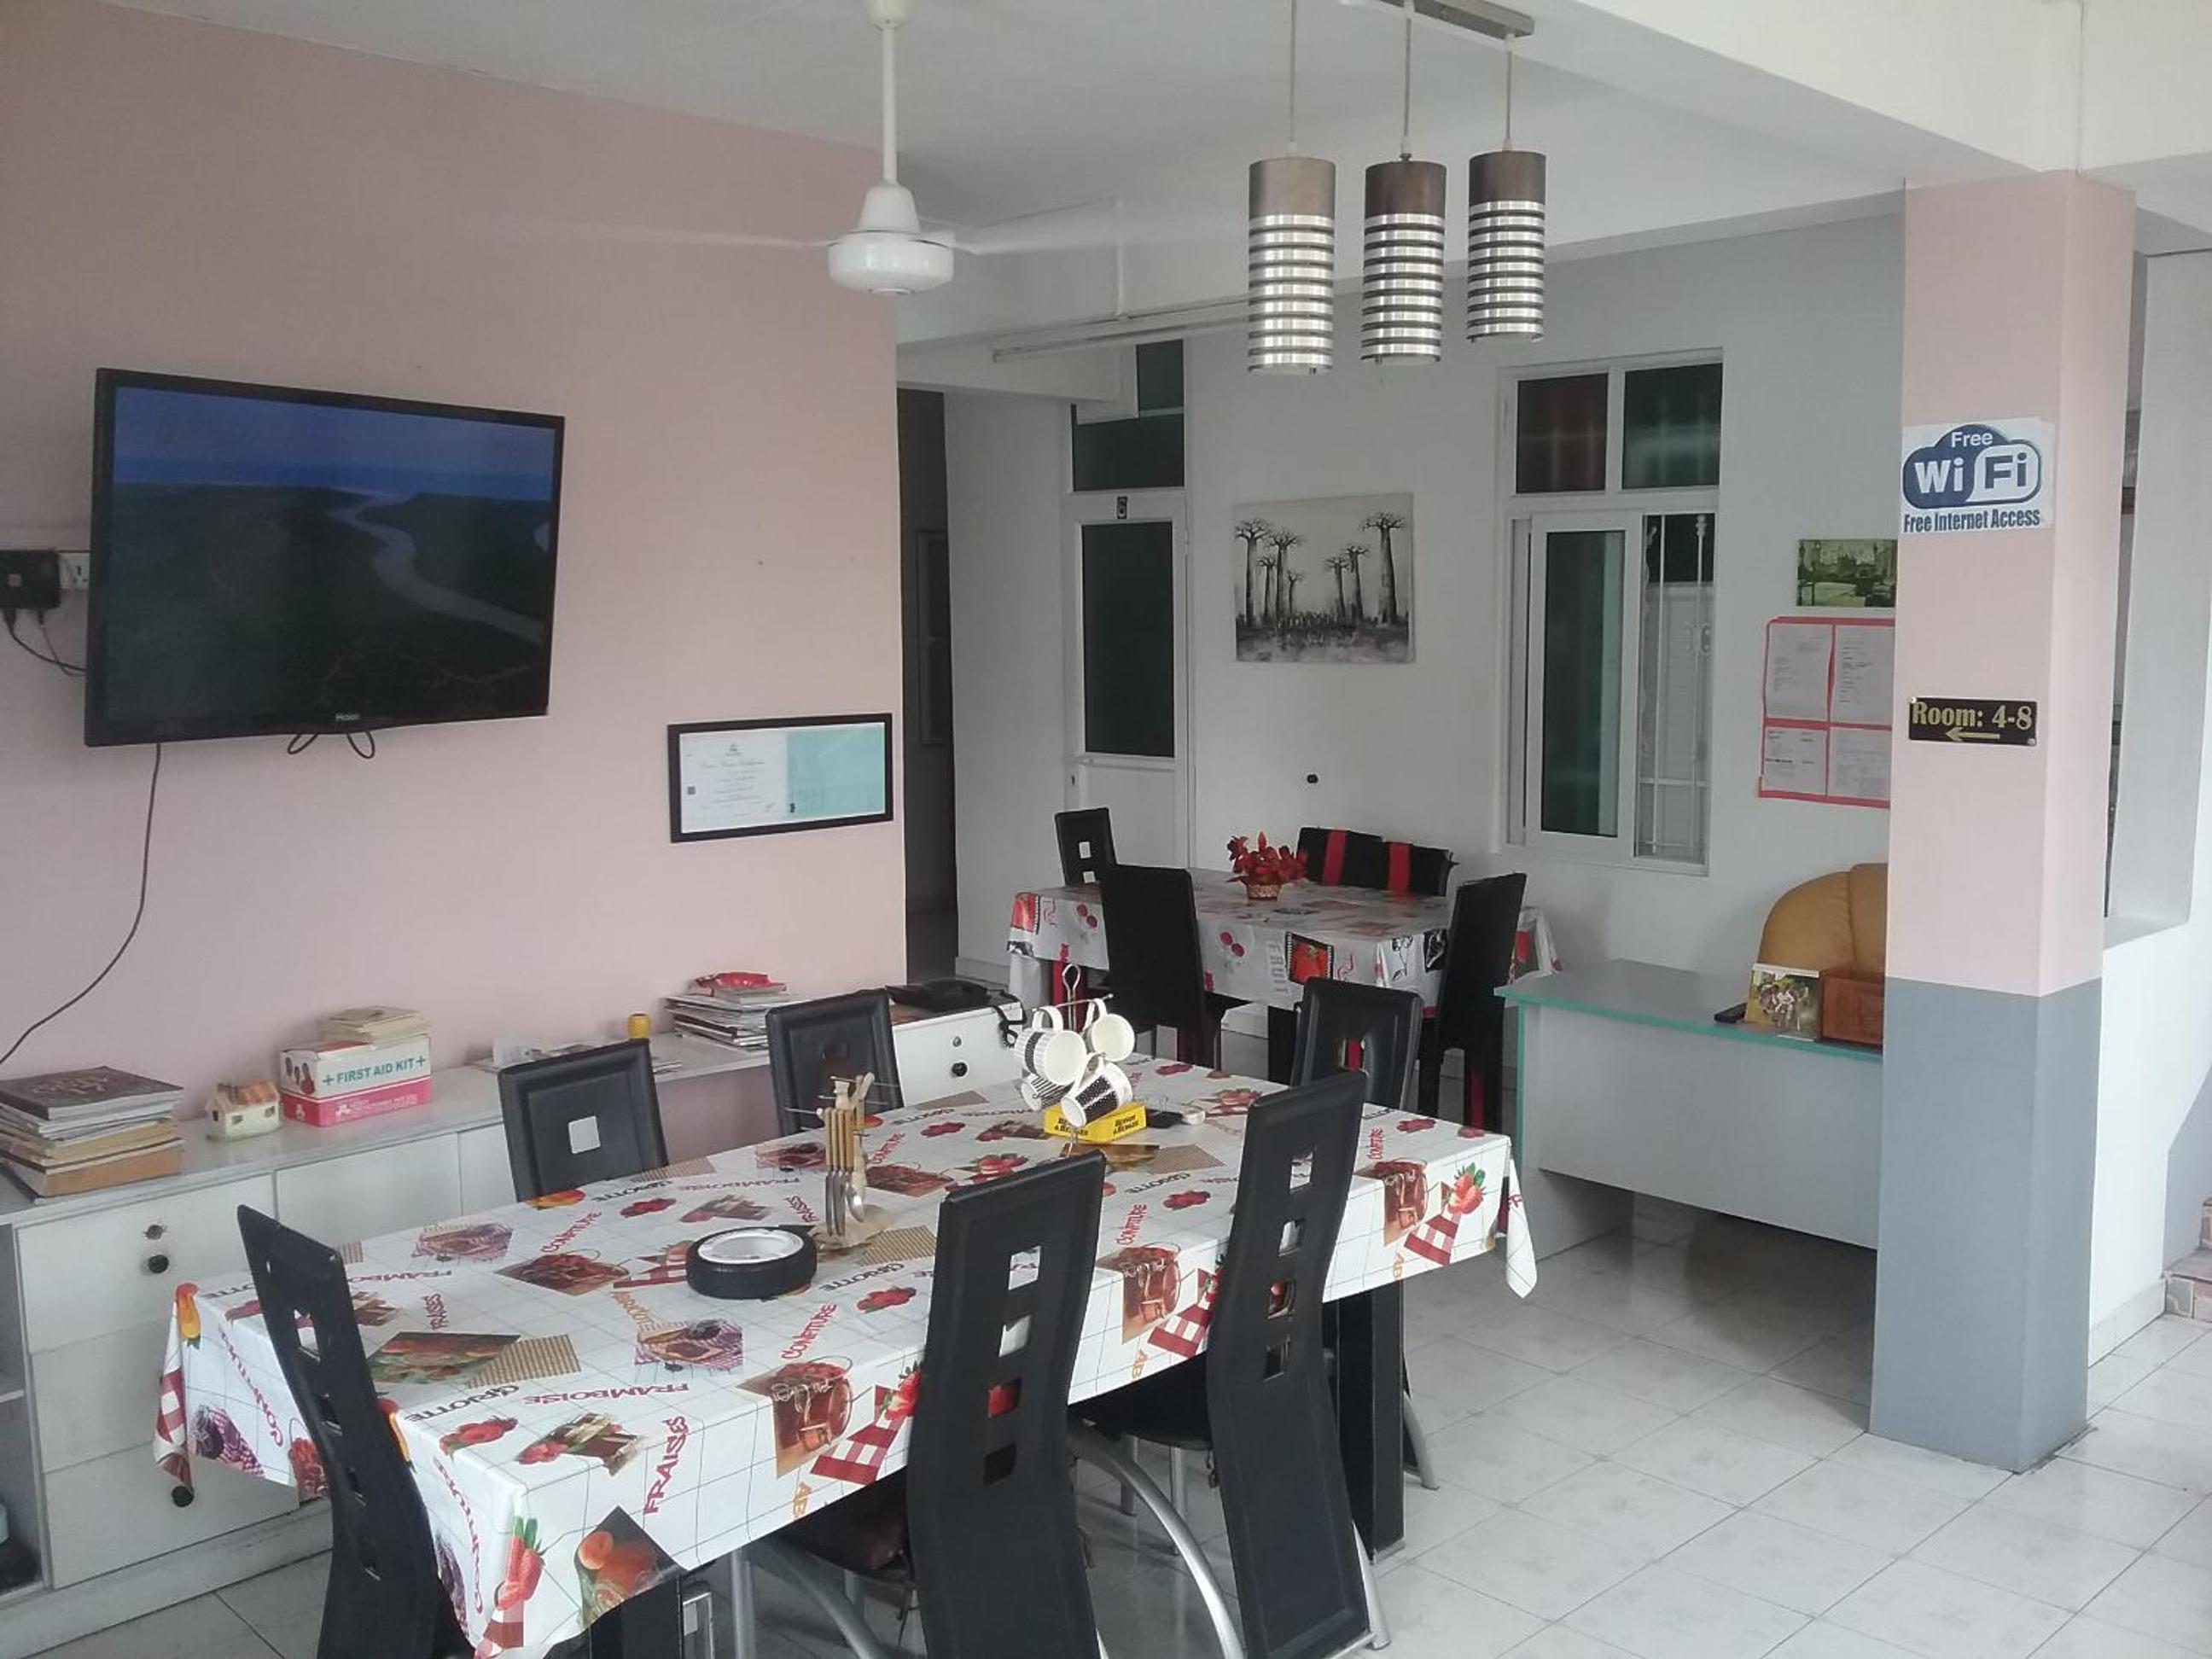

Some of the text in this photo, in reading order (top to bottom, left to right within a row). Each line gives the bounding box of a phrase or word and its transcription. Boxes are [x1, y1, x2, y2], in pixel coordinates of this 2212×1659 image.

[1951, 431, 1994, 448] Free
[1904, 508, 2040, 533] Free Internet Access
[1911, 701, 2033, 730] Room: 4-8
[336, 1058, 415, 1084] FIRST AID KIT
[781, 1303, 837, 1359] CONFITURE
[404, 1384, 520, 1423] GRIOTTE
[522, 1382, 690, 1406] FRAMBOISE
[643, 1415, 690, 1514] FRAISES
